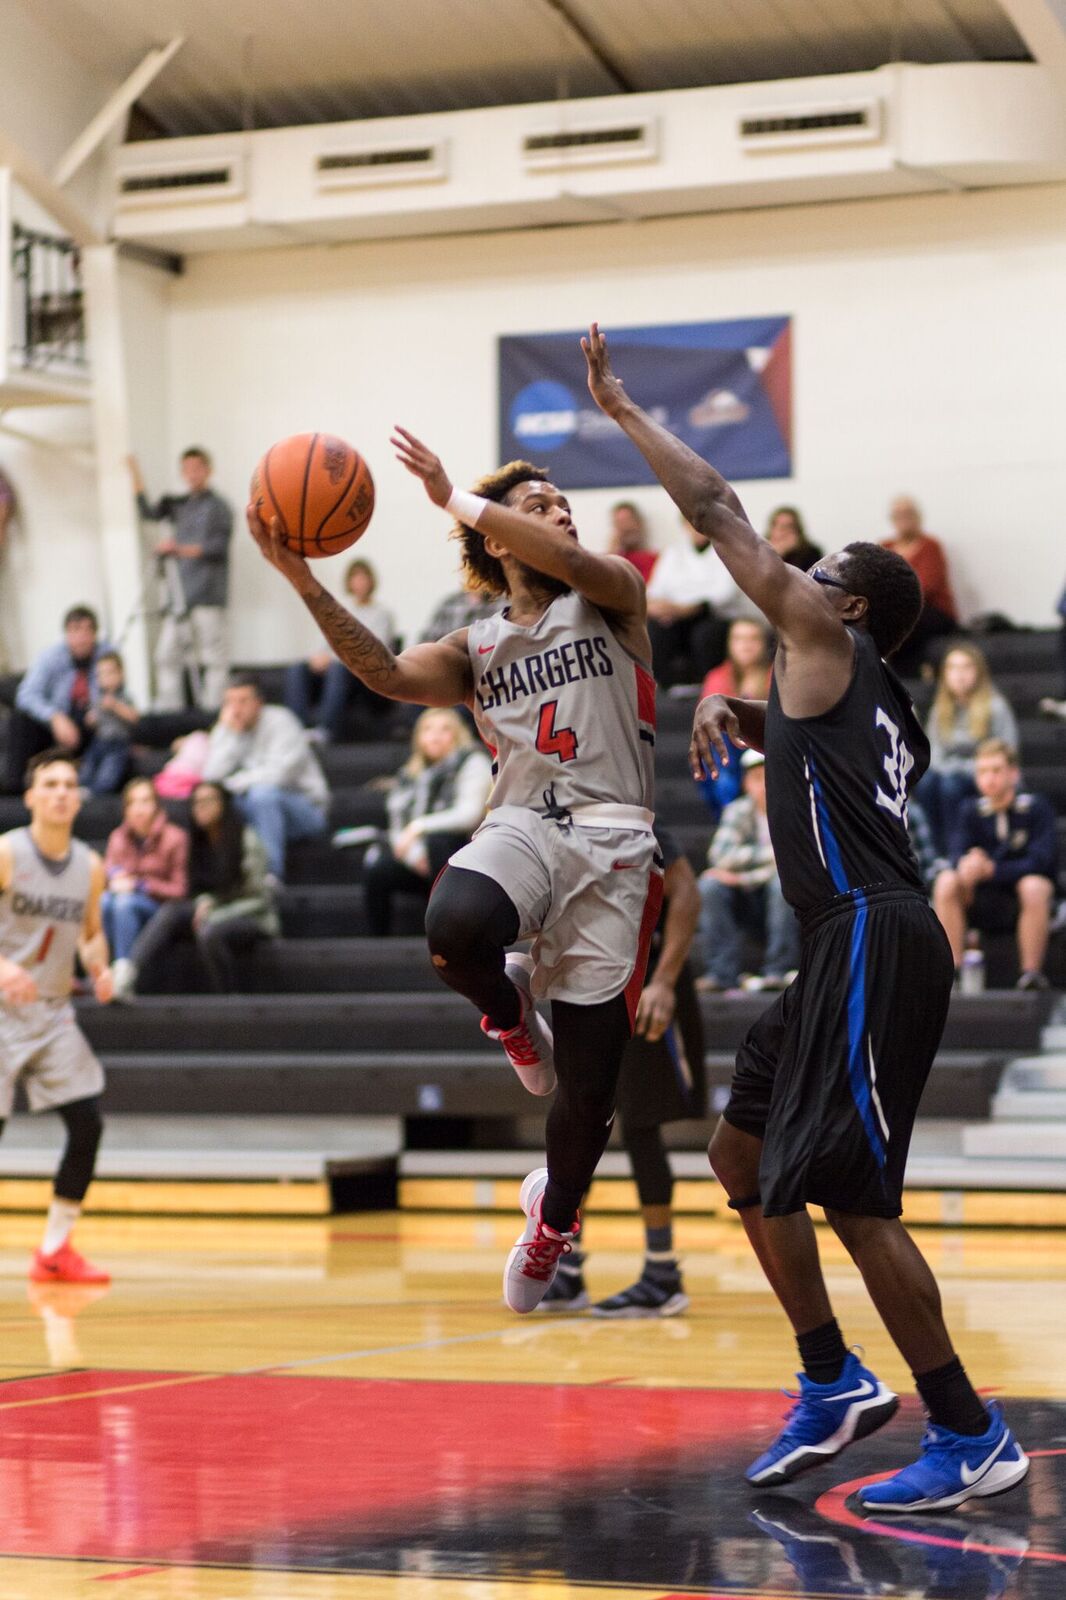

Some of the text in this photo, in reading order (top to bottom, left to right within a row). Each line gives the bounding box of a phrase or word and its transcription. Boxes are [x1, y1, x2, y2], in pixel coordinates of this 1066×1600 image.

[476, 636, 613, 711] CHARGERS
[535, 699, 578, 763] 4
[36, 925, 55, 964] 1
